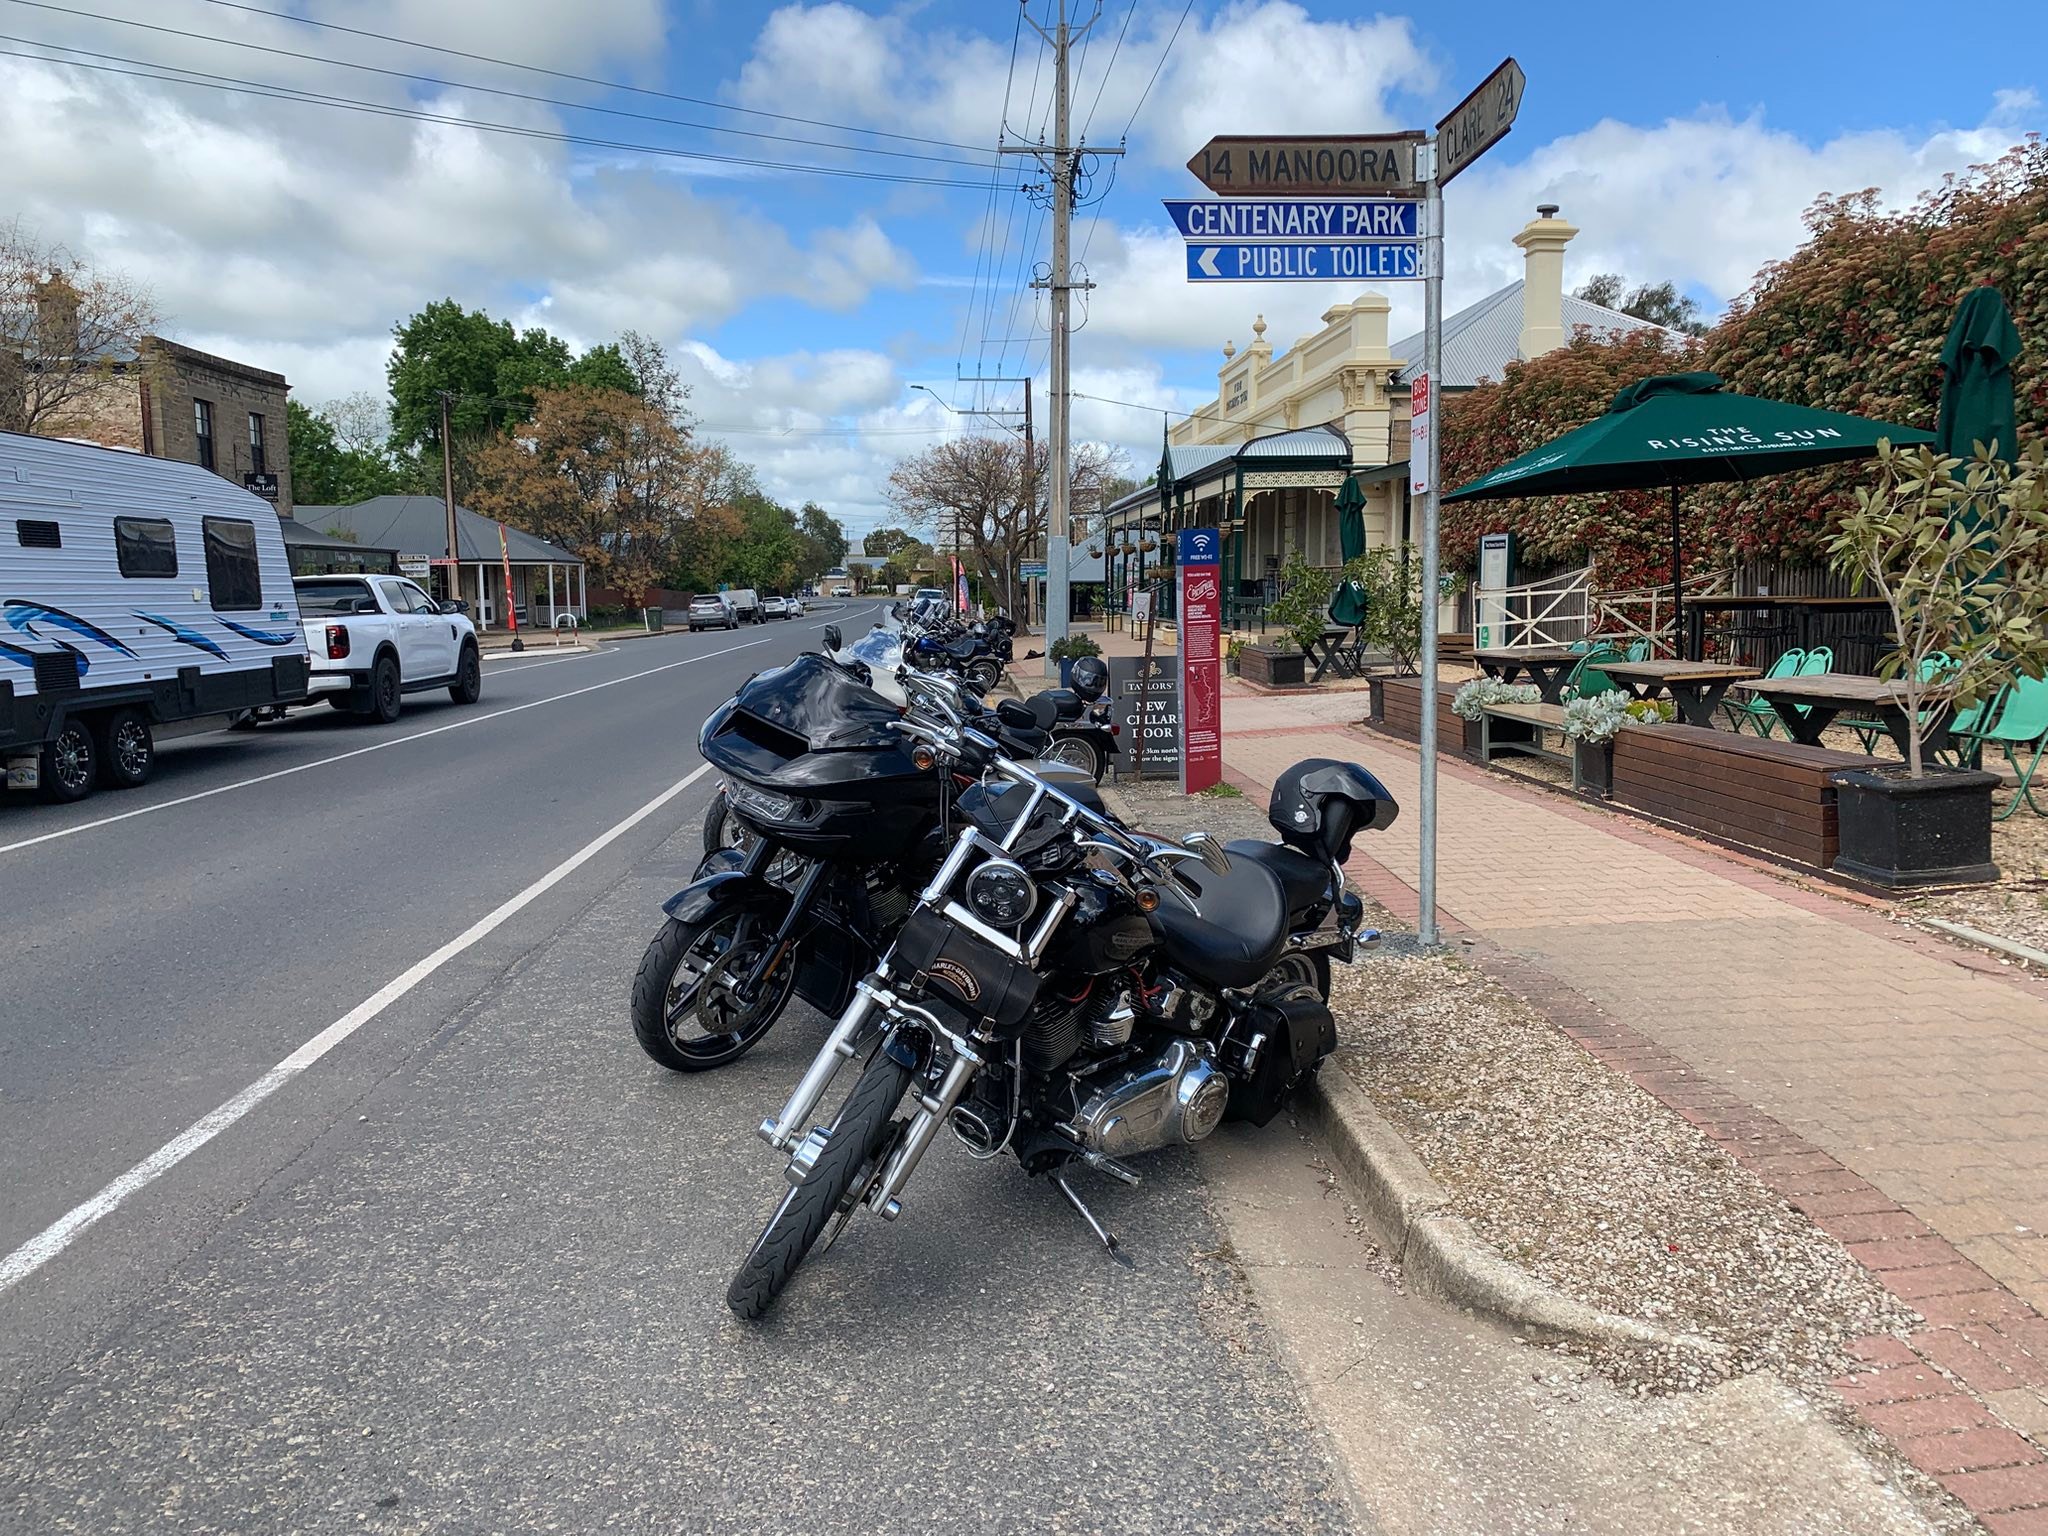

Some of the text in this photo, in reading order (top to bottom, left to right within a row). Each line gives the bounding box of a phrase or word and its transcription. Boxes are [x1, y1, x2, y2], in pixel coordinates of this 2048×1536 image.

[1446, 70, 1514, 164] CLARE 24
[1203, 148, 1401, 183] 14 MANOORA
[1188, 204, 1406, 235] CENTENARY PARK
[1238, 246, 1416, 276] PUBLIC TOILETS
[1413, 376, 1427, 396] BUS
[1412, 395, 1428, 416] ZONE
[1647, 427, 1842, 450] RISING SUN
[1706, 426, 1751, 436] THE
[261, 483, 277, 491] Loft
[1127, 682, 1174, 691] TALORS'
[1152, 754, 1162, 762] the
[1160, 746, 1178, 754] north
